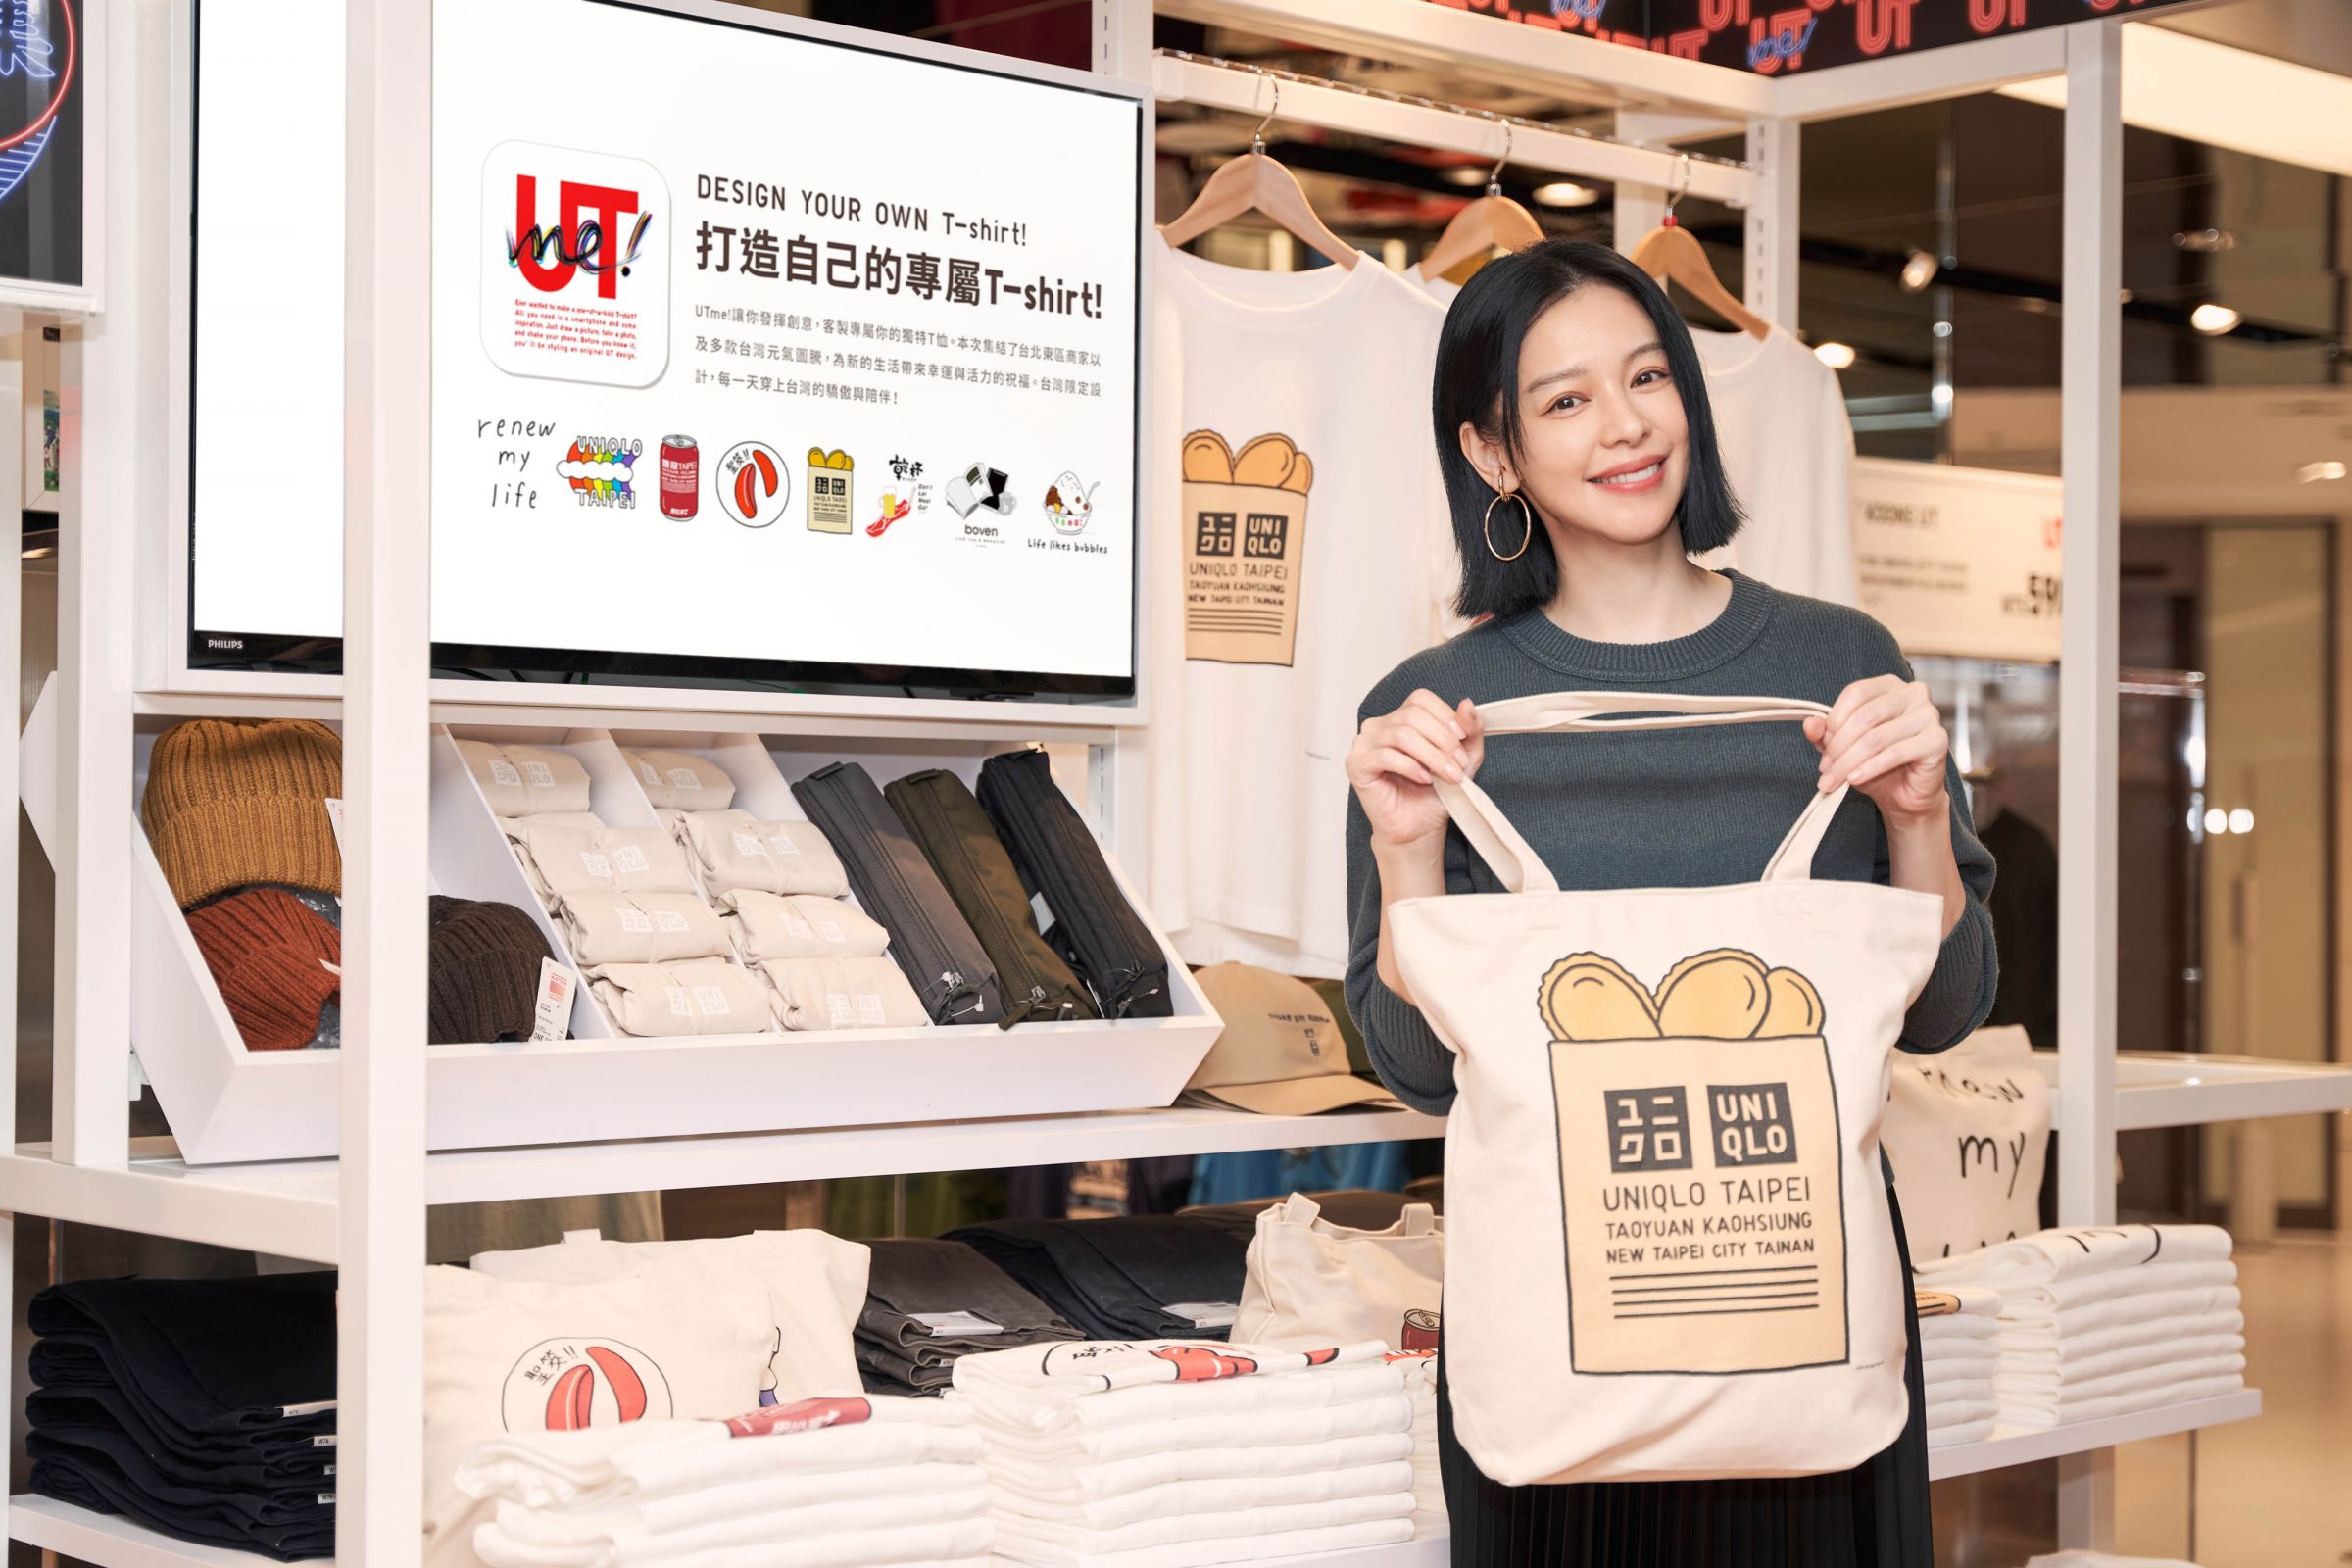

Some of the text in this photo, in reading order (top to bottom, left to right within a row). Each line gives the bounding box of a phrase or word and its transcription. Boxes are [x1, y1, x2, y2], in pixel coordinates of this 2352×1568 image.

[697, 173, 1027, 247] DESIGN YOUR OWN T-shirt!
[516, 173, 639, 300] UT
[695, 220, 1102, 319] 打造自己的專屬T-shirt!
[477, 418, 556, 438] renew
[576, 435, 643, 457] UNIQLO
[498, 449, 531, 472] my
[491, 481, 537, 509] life
[574, 488, 636, 509] TAIPEI
[964, 524, 999, 537] boven
[1027, 538, 1108, 555] Life likes bubbles
[1189, 562, 1288, 580] UNIQLO TAIPEI
[208, 639, 243, 649] PHILIPS
[1958, 1131, 2027, 1200] my
[1602, 1176, 1811, 1213] UNIQLO TAIPEI
[1604, 1211, 1813, 1241] TAOYUAN KAOHSIUNG
[1606, 1238, 1815, 1264] NEW TAIPEI CITY TAINAN
